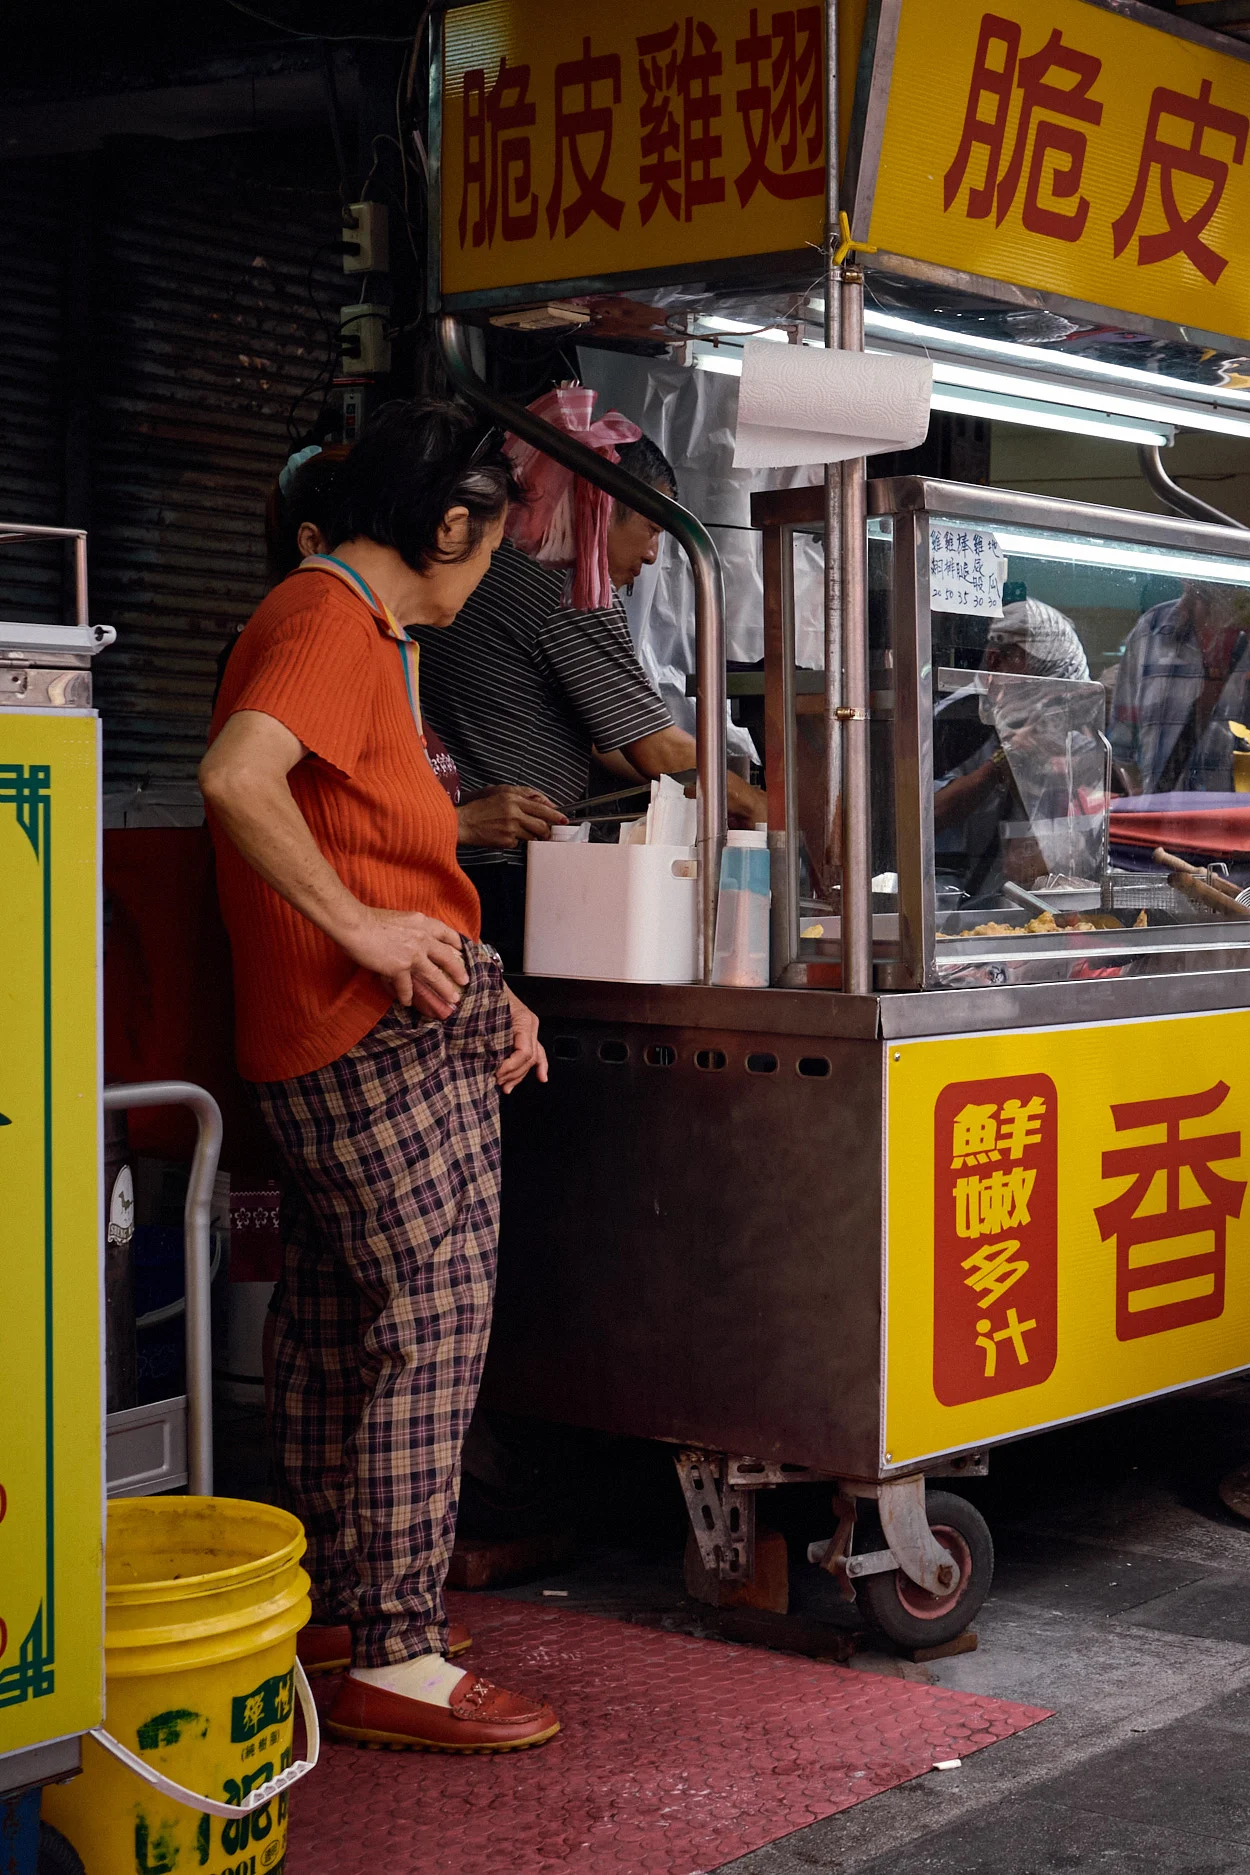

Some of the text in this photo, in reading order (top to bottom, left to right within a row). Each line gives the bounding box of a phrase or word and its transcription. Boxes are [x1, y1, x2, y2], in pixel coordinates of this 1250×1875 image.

[458, 5, 825, 250] 脆皮雞翅
[987, 540, 1001, 599] 地瓜
[945, 588, 954, 600] 50
[957, 591, 969, 605] 35
[973, 595, 984, 608] 30
[987, 597, 997, 608] 30
[952, 1096, 1046, 1378] 鮮嫩多汁
